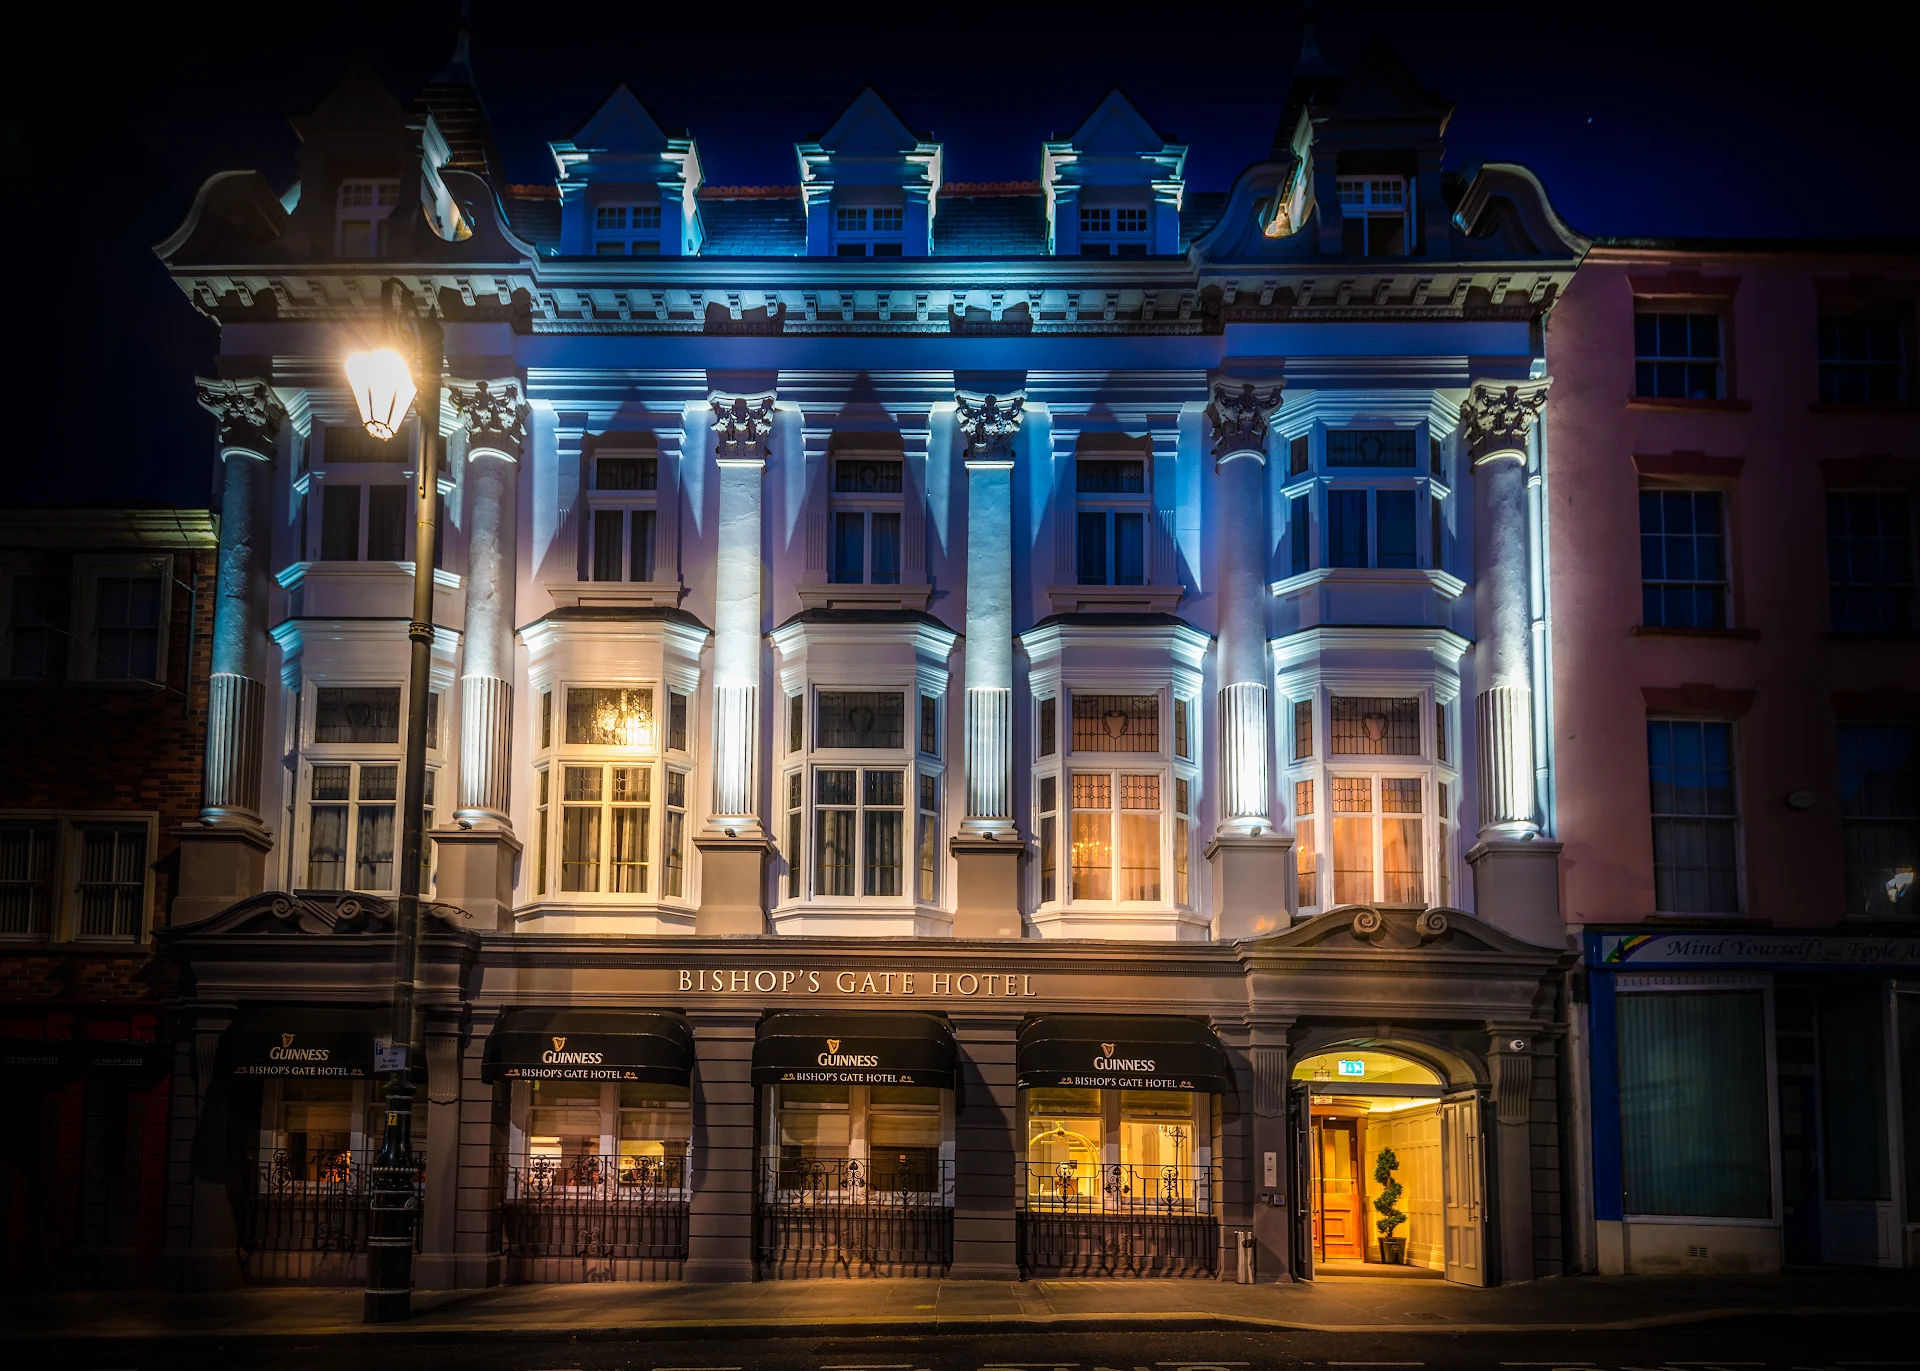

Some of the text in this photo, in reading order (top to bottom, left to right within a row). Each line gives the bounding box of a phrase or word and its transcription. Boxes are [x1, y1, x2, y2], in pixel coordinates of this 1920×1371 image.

[1666, 939, 1729, 955] Mind
[1731, 939, 1822, 961] Yourself!
[1846, 940, 1897, 962] Foyle
[678, 970, 1036, 996] BISHOP'S GATE HOTEL
[269, 1046, 330, 1061] GUINNESS
[542, 1050, 603, 1064] GUINNESS
[817, 1053, 879, 1067] GUINNESS
[249, 1066, 349, 1076] BISHOP'S GATE HOTEL
[1093, 1056, 1156, 1072] GUINNESS
[521, 1068, 622, 1079] BISHOP'S GATE HOTEL
[796, 1072, 897, 1083] BISHOP'S GATE HOTEL
[1075, 1076, 1177, 1088] BISHOP'S GATE HOTEL
